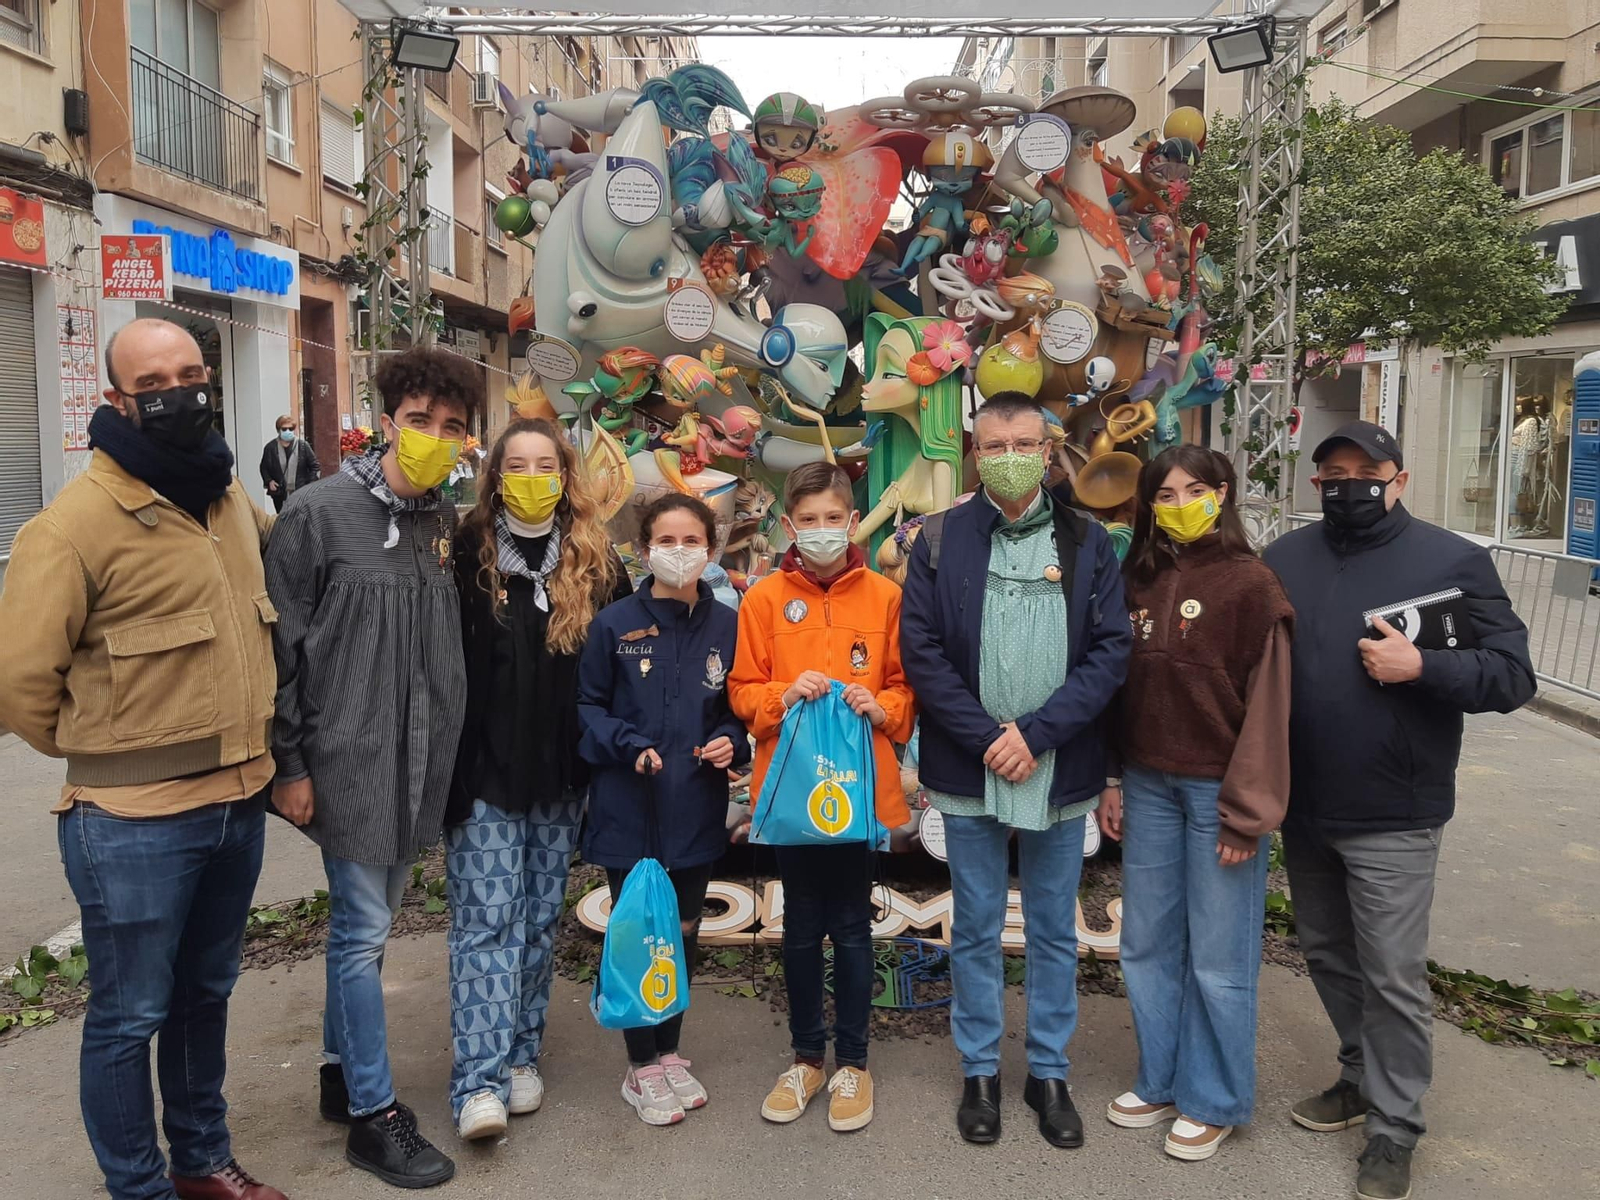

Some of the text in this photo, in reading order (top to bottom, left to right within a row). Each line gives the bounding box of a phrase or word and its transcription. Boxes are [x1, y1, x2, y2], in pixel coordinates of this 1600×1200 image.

[1018, 115, 1025, 125] 8
[612, 157, 617, 168] 1
[112, 259, 153, 269] ANGEL
[112, 269, 155, 279] KEBAB
[236, 248, 294, 295] SHOP
[104, 279, 163, 289] PIZZERIA
[671, 278, 677, 288] 9
[1050, 299, 1056, 309] 6
[531, 332, 540, 340] 10
[1445, 615, 1453, 634] MEDIA
[616, 643, 653, 654] Lucía
